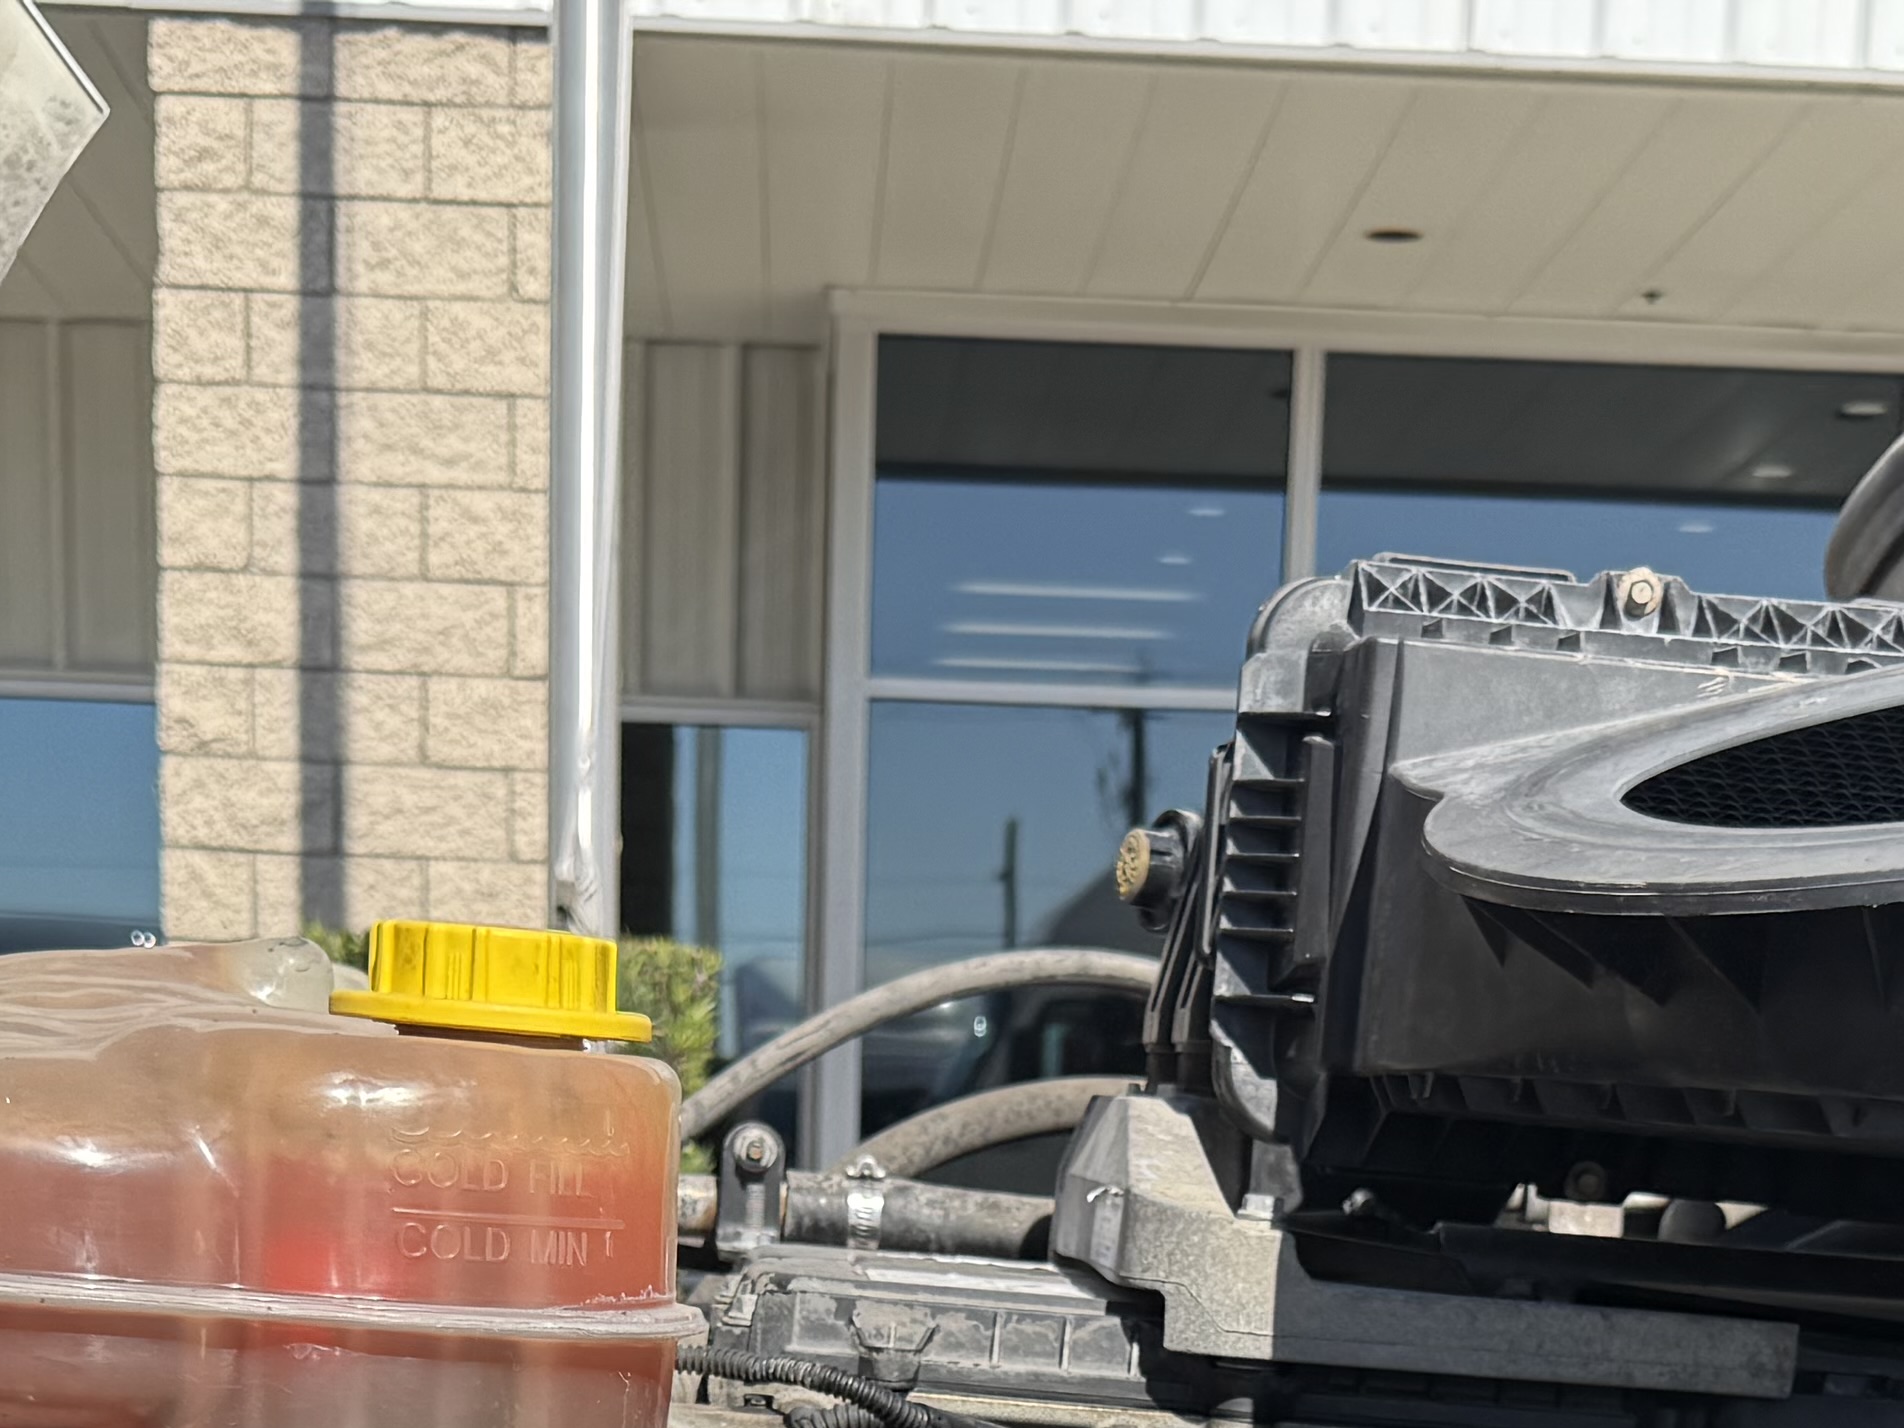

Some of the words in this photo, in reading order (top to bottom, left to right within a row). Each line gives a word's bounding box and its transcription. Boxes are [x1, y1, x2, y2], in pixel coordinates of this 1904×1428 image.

[393, 1148, 508, 1192] COLD
[400, 1222, 510, 1262] COLD
[531, 1228, 587, 1267] MIN
